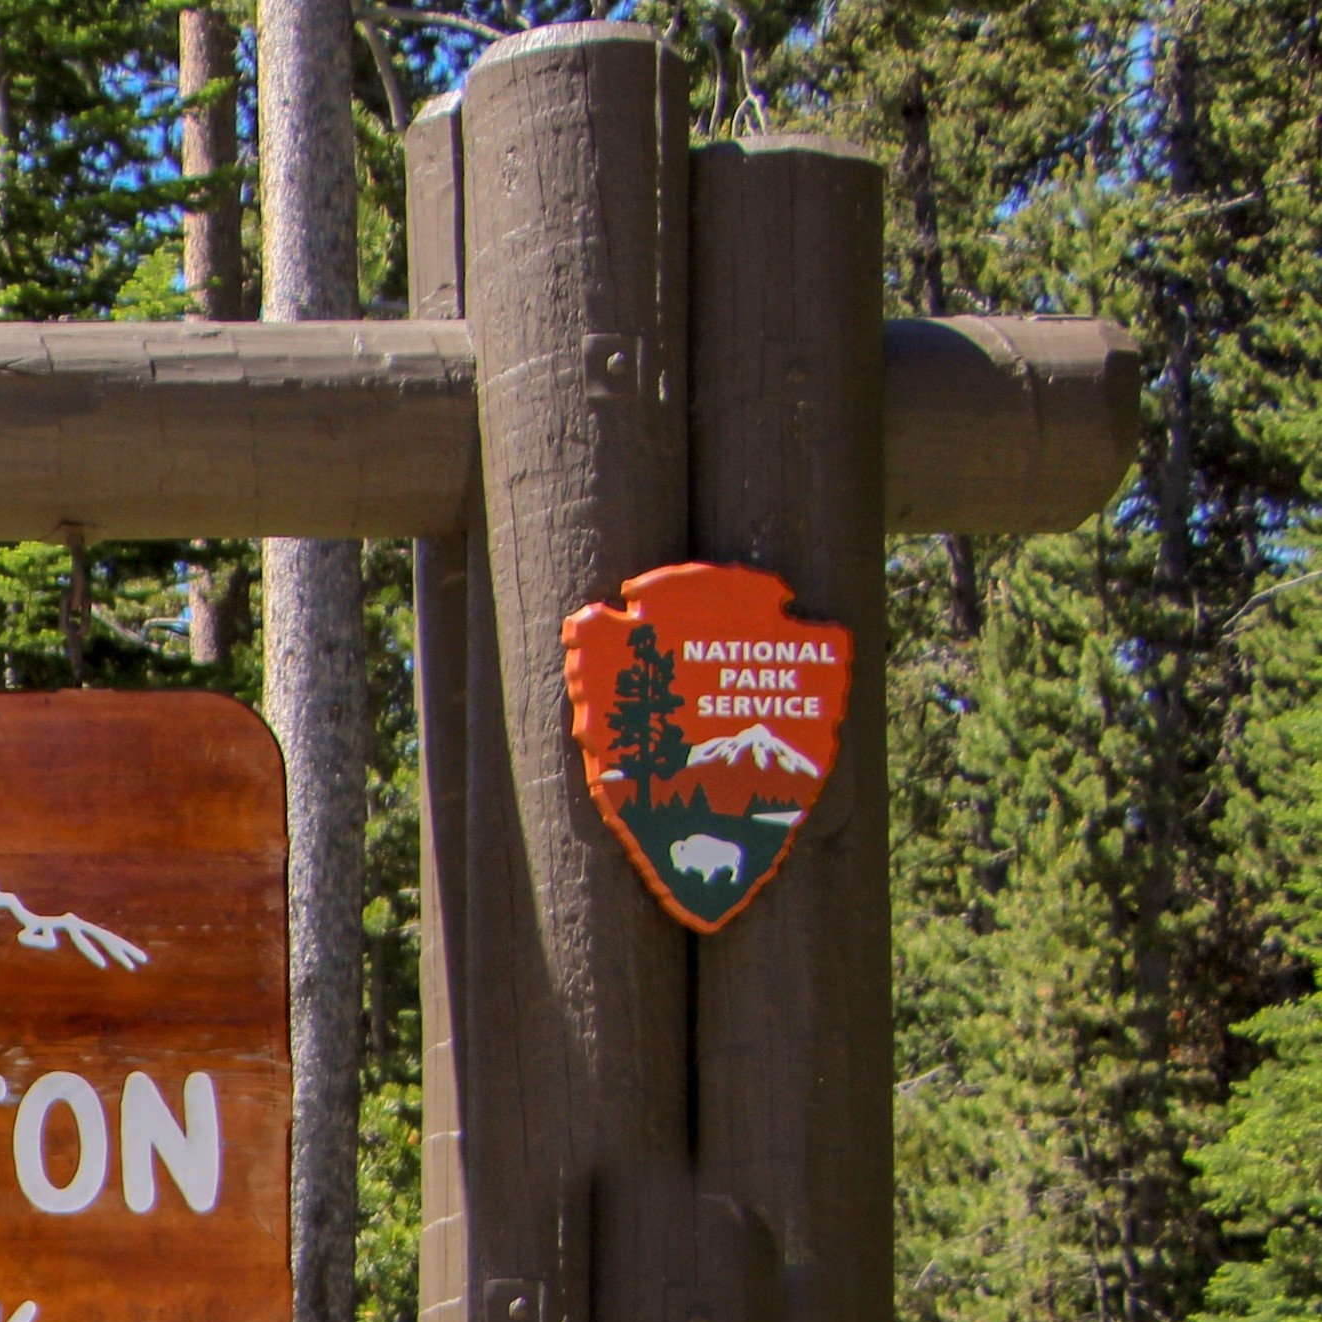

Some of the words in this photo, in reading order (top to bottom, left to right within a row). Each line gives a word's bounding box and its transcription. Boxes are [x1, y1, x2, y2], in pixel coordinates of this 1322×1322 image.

[683, 640, 835, 662] NATIONAL
[719, 668, 796, 690] PARK
[697, 695, 820, 718] SERVICE
